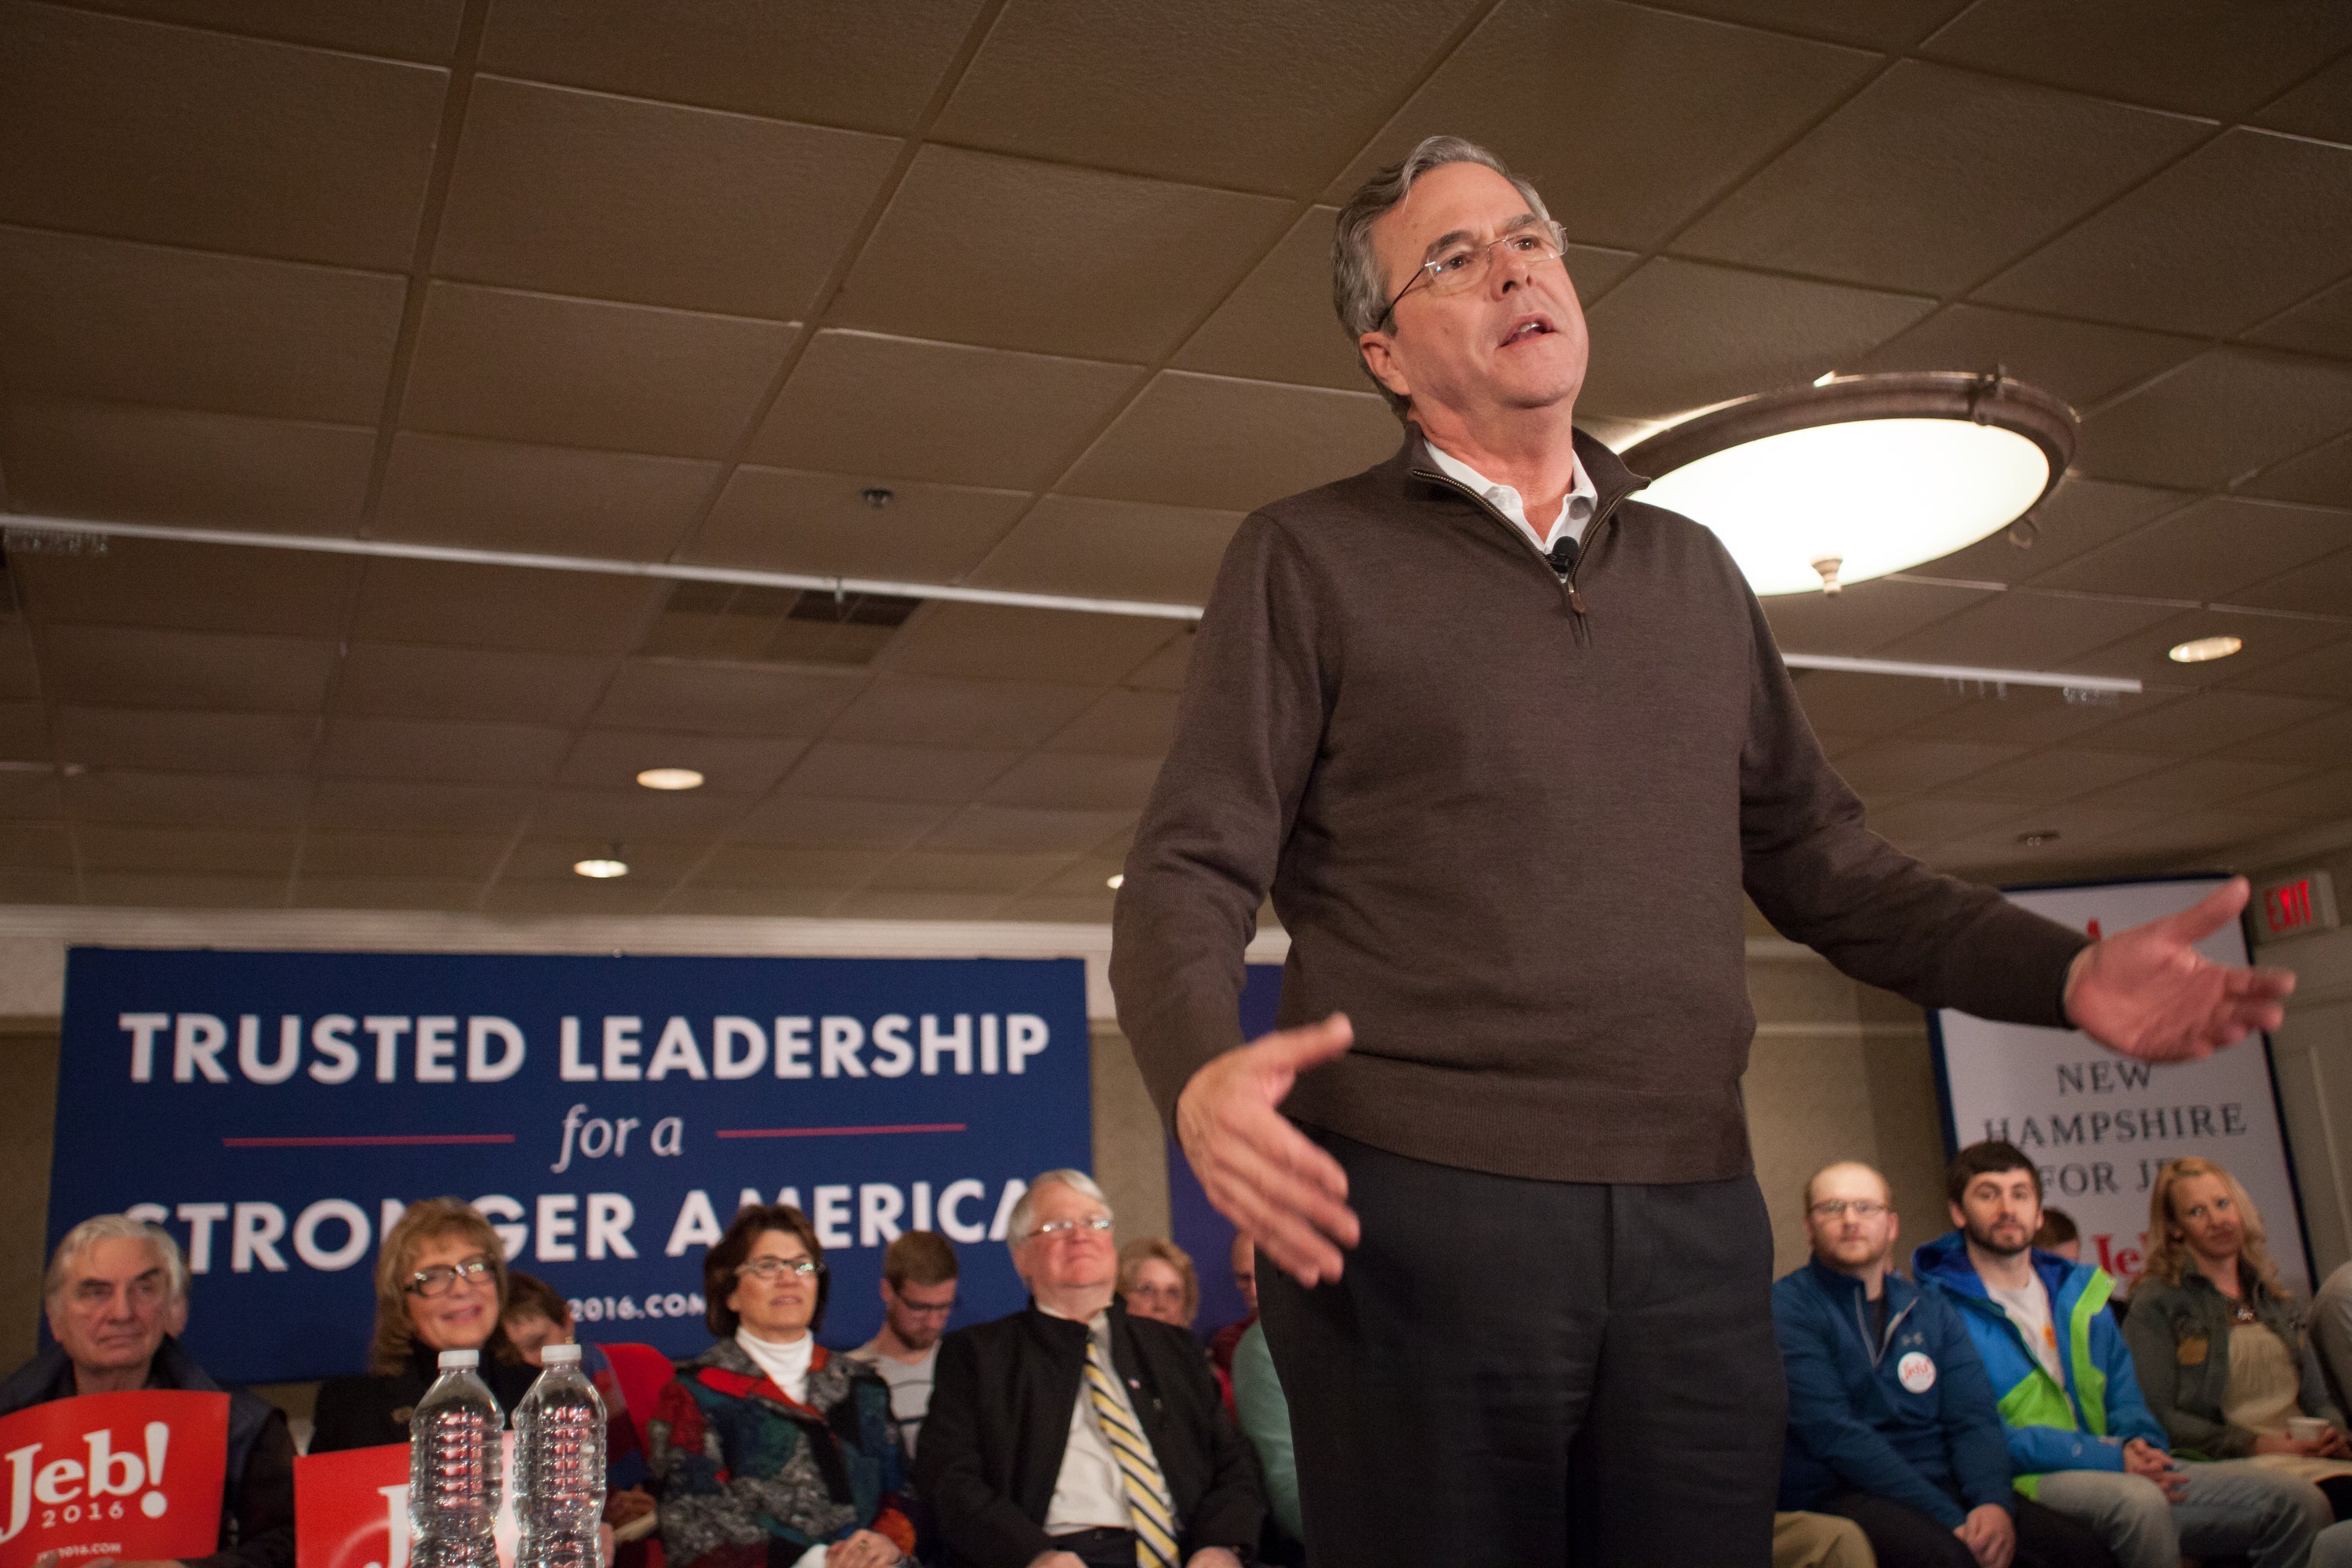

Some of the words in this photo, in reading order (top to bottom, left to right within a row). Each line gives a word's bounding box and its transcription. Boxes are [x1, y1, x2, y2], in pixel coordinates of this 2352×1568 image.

[2263, 879, 2312, 933] EXIT
[118, 1012, 527, 1085] TRUSTED
[560, 1014, 1050, 1081] LEADERSHIP
[2056, 1060, 2153, 1095] NEW
[550, 1104, 641, 1173] for
[650, 1116, 684, 1156] a
[1984, 1102, 2248, 1149] HAMPSHIRE
[0, 1421, 170, 1544] Jeb!
[42, 1501, 124, 1529] 2016
